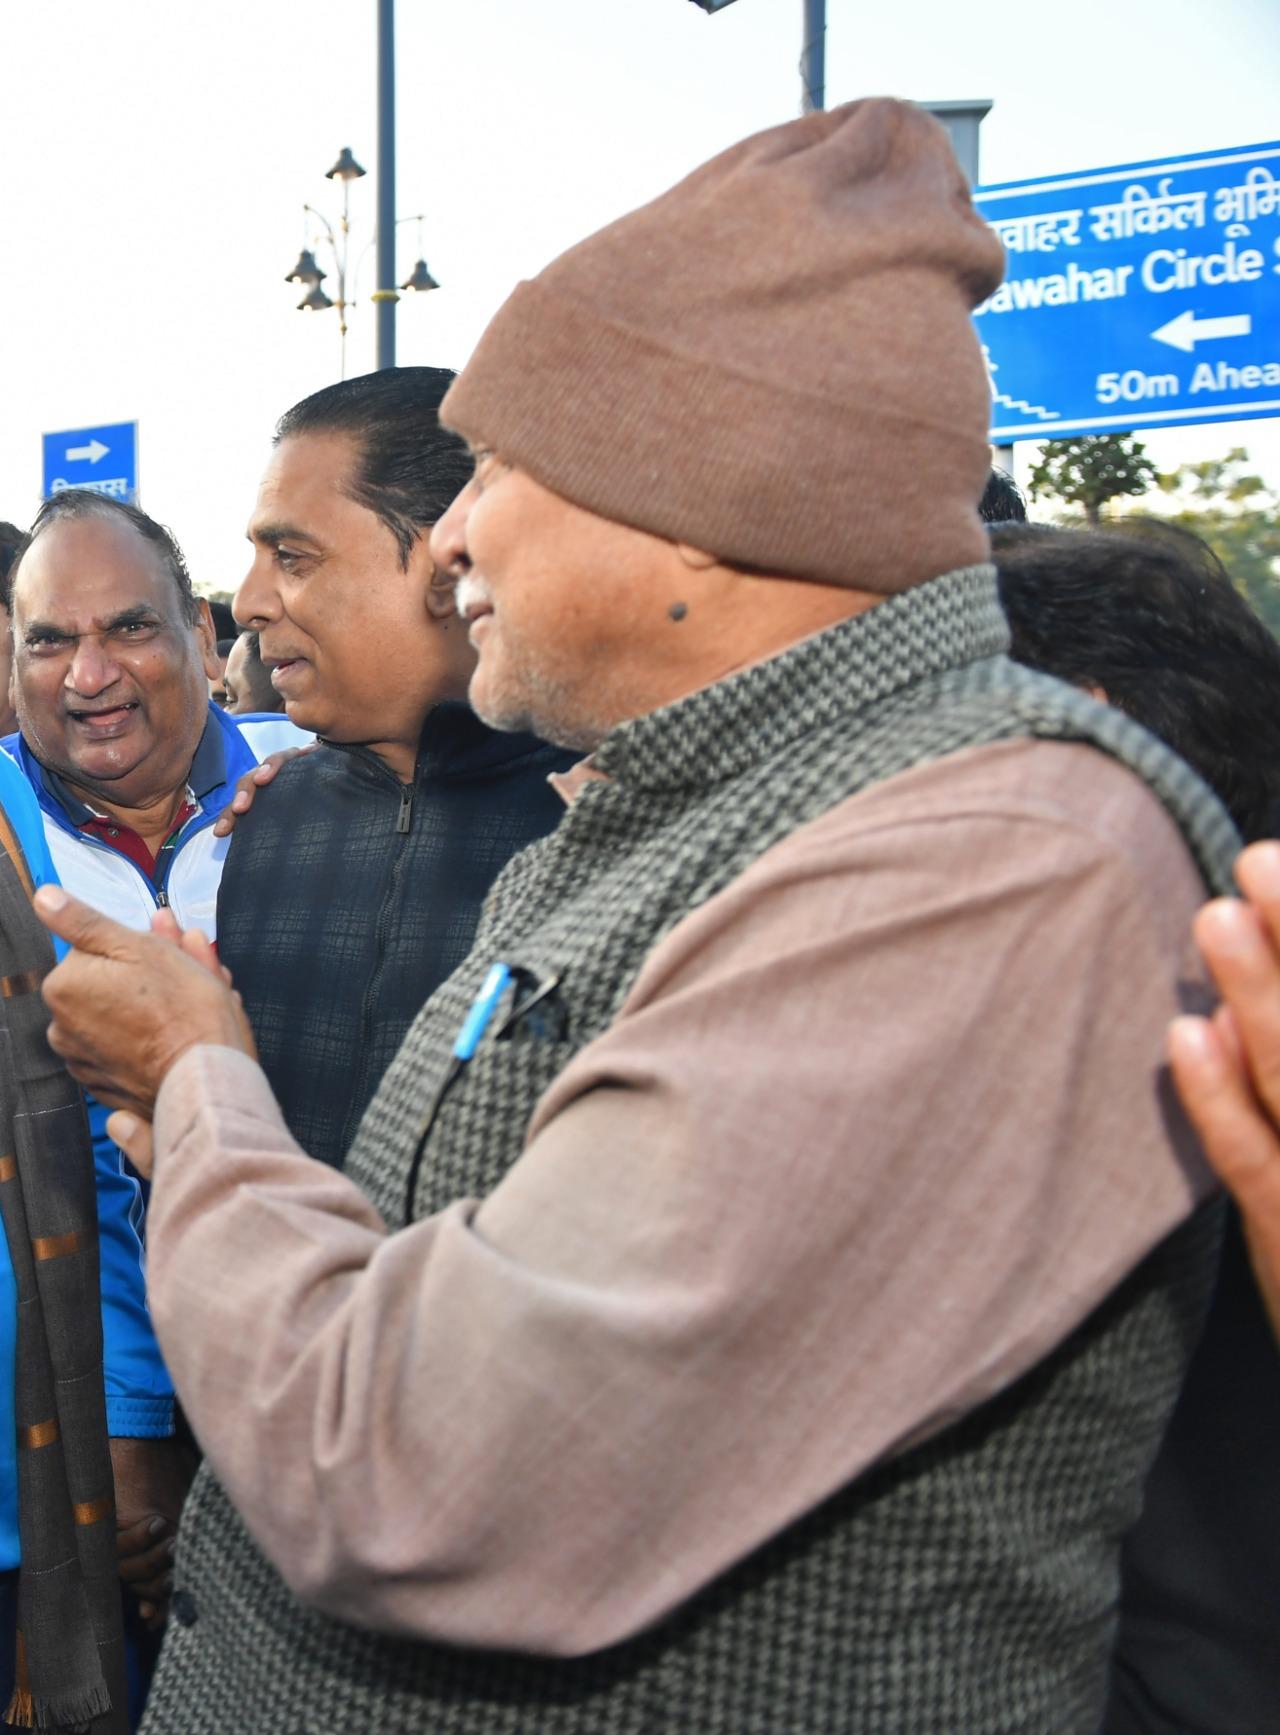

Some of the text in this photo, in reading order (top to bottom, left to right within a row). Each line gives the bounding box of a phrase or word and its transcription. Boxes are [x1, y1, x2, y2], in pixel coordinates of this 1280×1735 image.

[985, 209, 1083, 253] वाहर
[1088, 178, 1207, 241] सर्किल
[972, 262, 1134, 316] awahar
[1141, 241, 1265, 292] Circle
[1096, 370, 1179, 404] 50m
